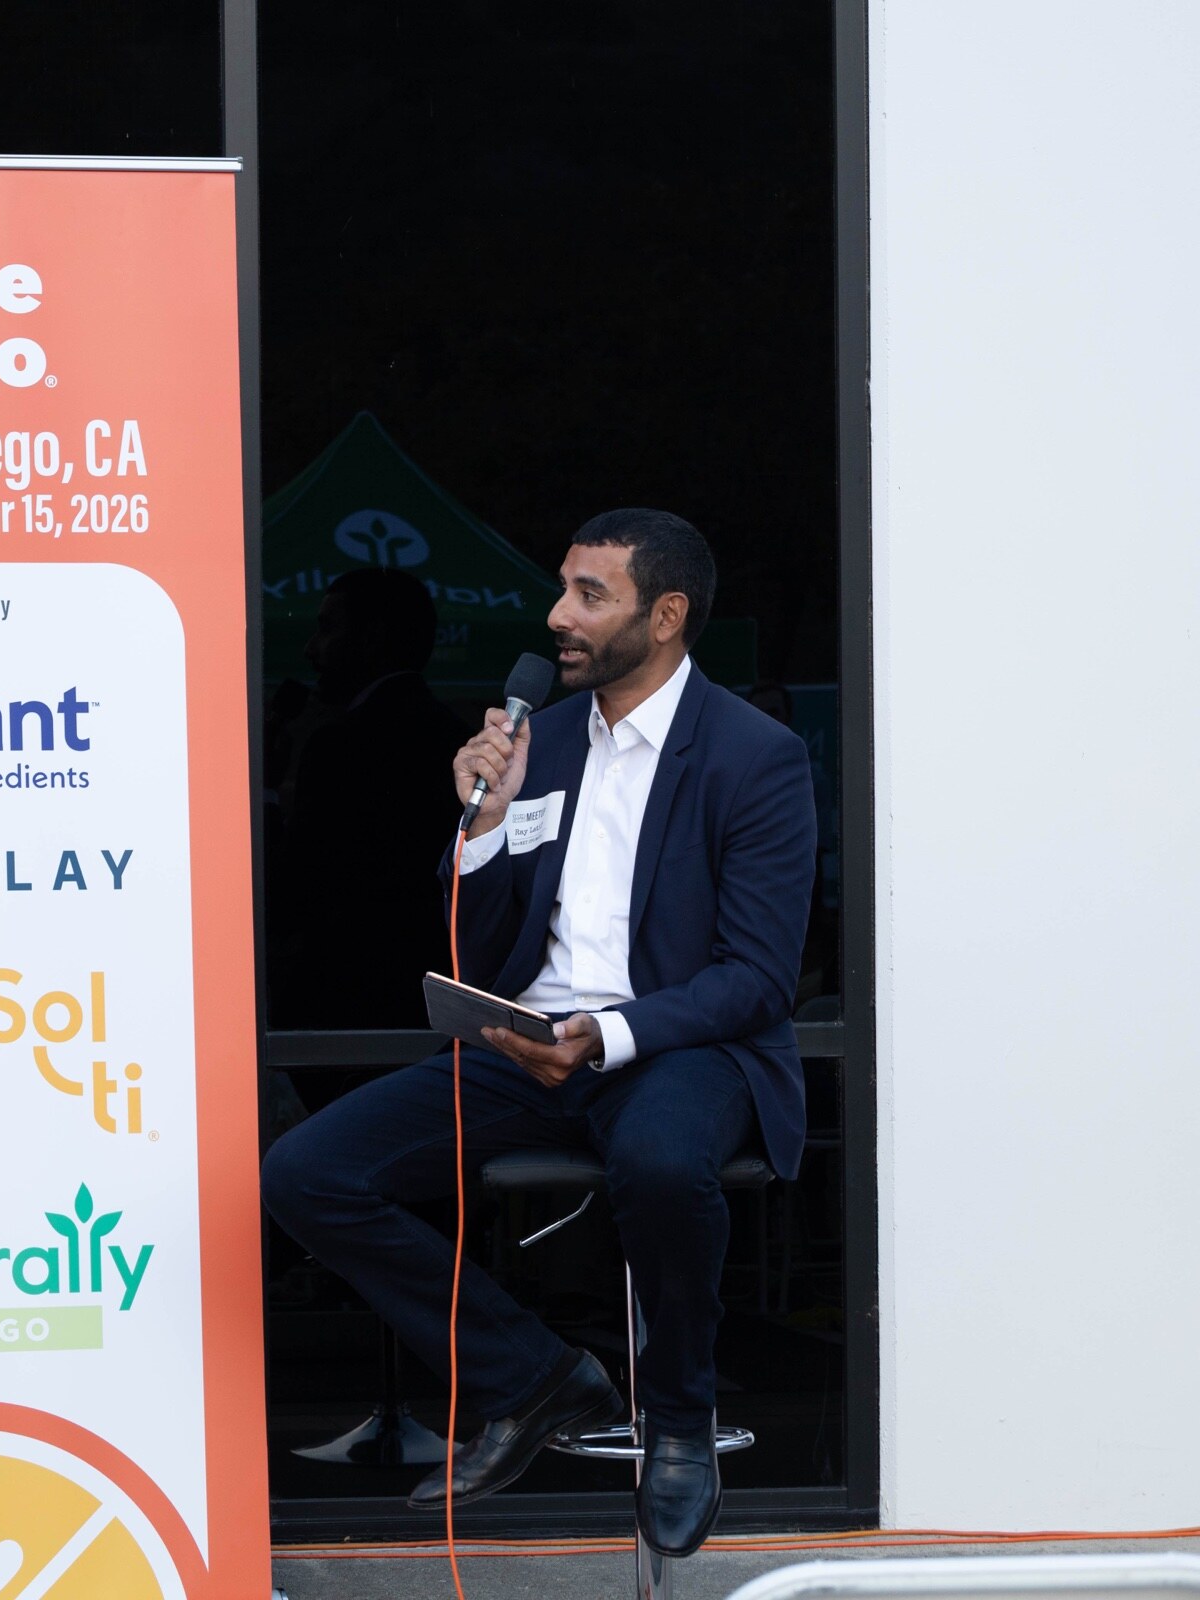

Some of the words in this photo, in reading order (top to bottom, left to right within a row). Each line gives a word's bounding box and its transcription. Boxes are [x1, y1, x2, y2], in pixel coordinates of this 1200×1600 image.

[85, 419, 148, 477] CA
[23, 496, 63, 538] 15,
[71, 495, 149, 534] 2026
[515, 828, 528, 837] Ray
